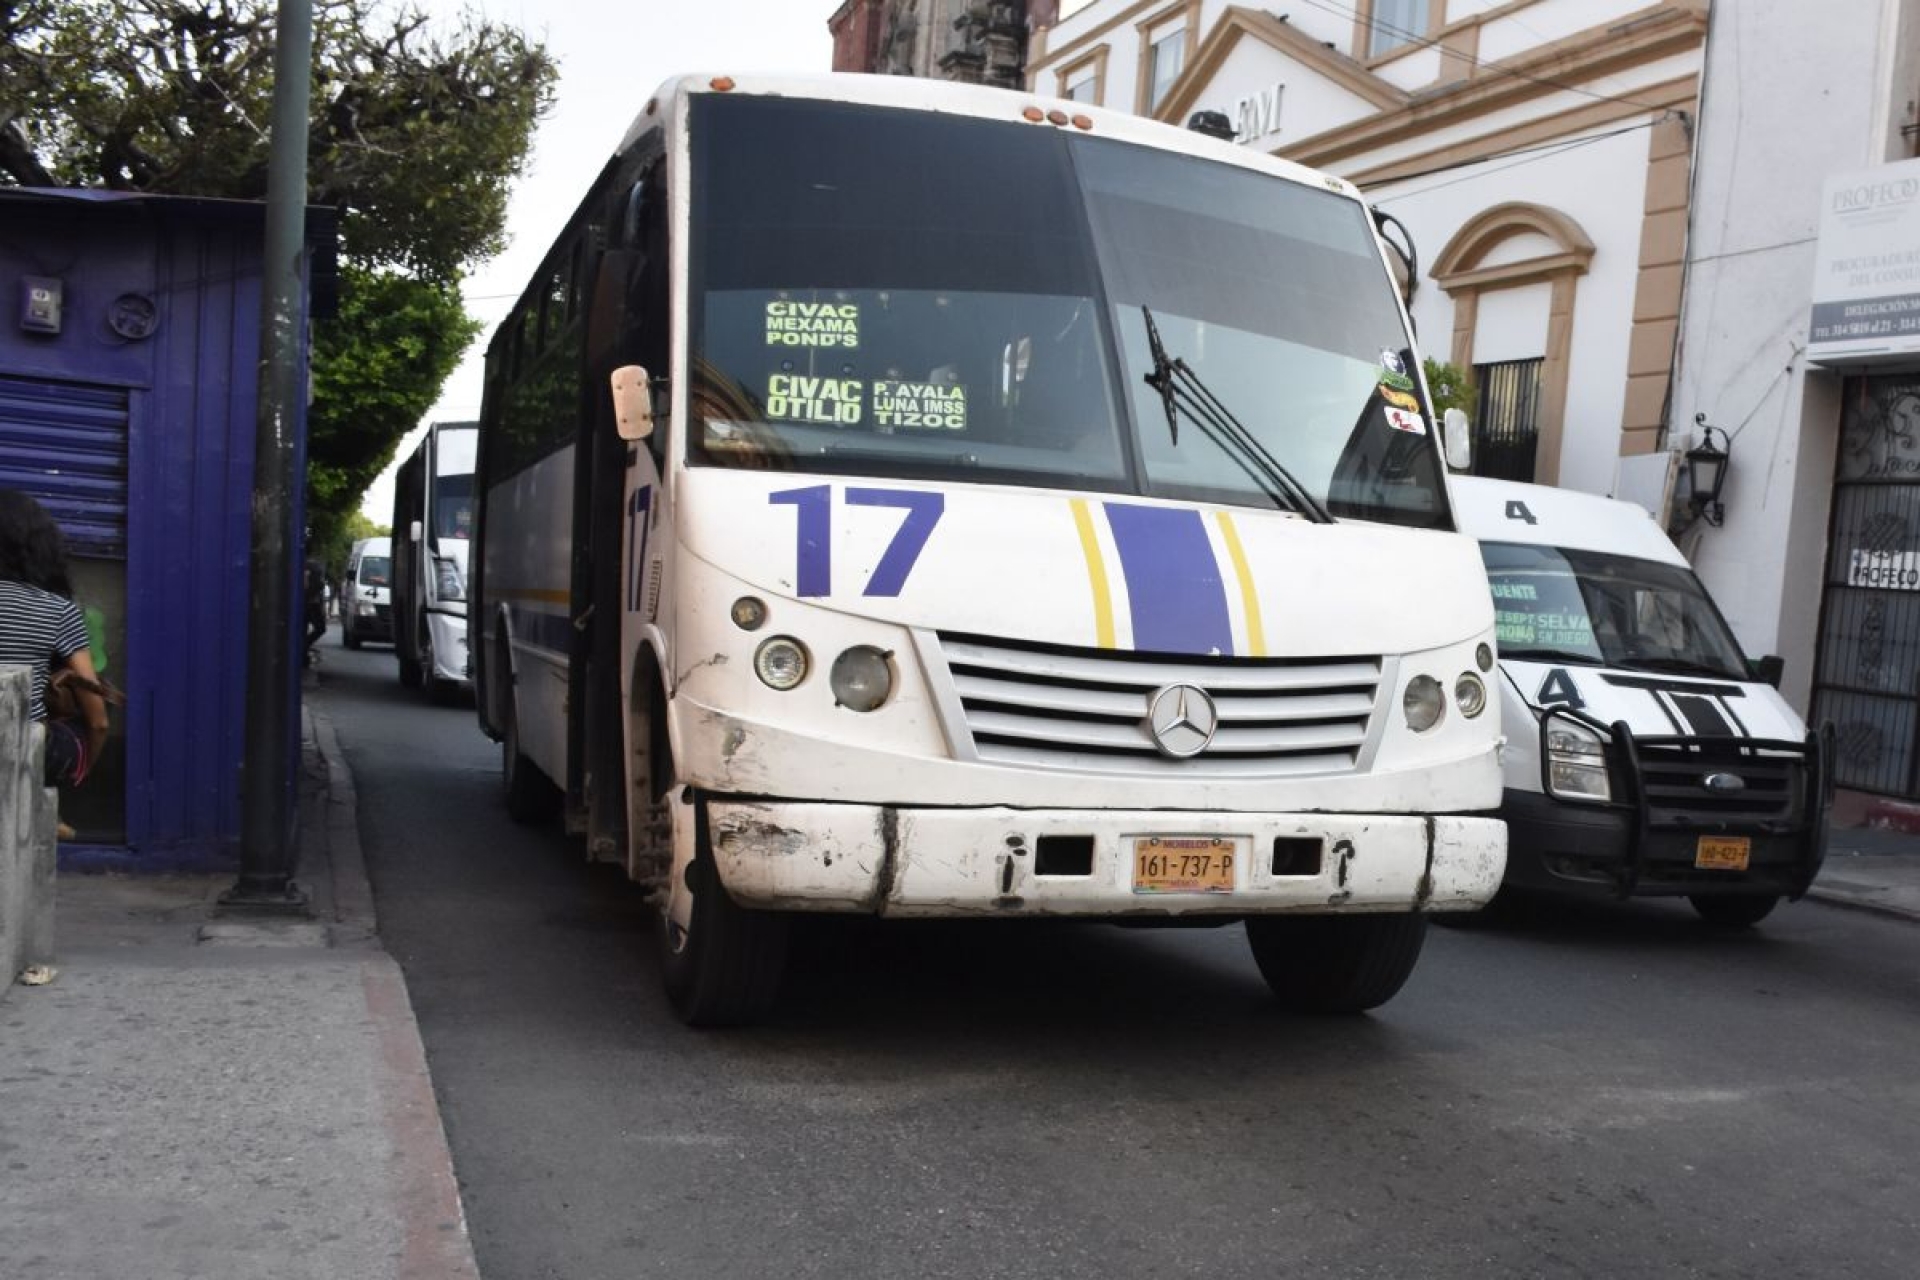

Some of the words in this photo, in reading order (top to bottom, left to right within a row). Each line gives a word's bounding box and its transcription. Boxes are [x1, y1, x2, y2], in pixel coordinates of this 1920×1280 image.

[766, 302, 858, 318] CIVAC
[767, 317, 857, 332] MEXAMA
[766, 332, 858, 347] POND'S
[768, 374, 862, 402] CIVAC
[874, 382, 890, 396] P.
[895, 384, 964, 400] AYALA
[767, 397, 861, 424] OTILIO
[873, 397, 919, 412] LUNA
[923, 400, 965, 415] IMSS
[874, 411, 964, 428] TIZOC
[1505, 500, 1538, 525] 4
[769, 484, 945, 597] 17
[1853, 566, 1919, 586] PROFECO
[1538, 614, 1591, 631] SELVA
[1538, 669, 1586, 709] 4
[1140, 855, 1233, 877] 161-737-P
